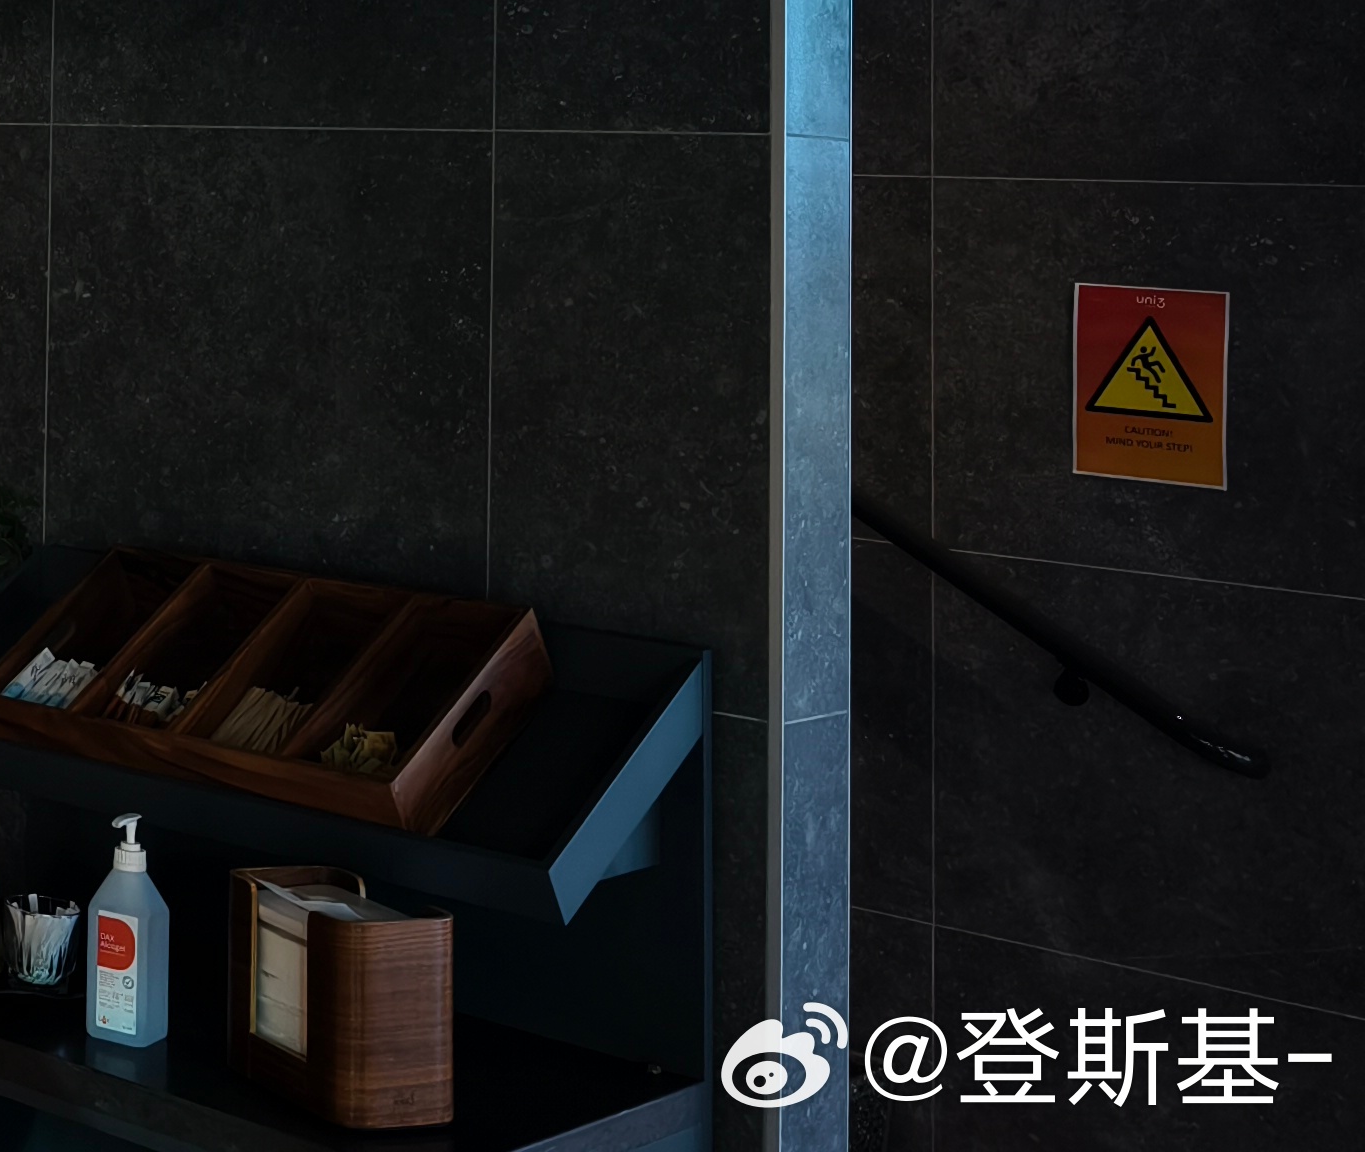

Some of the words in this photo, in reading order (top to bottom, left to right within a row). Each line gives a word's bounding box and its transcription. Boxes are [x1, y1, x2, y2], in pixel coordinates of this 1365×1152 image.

[1136, 295, 1166, 309] uni3
[1124, 425, 1173, 437] CAUTION!
[1105, 436, 1134, 447] MIND
[1135, 439, 1163, 450] YOUR
[1165, 442, 1193, 453] STEP!
